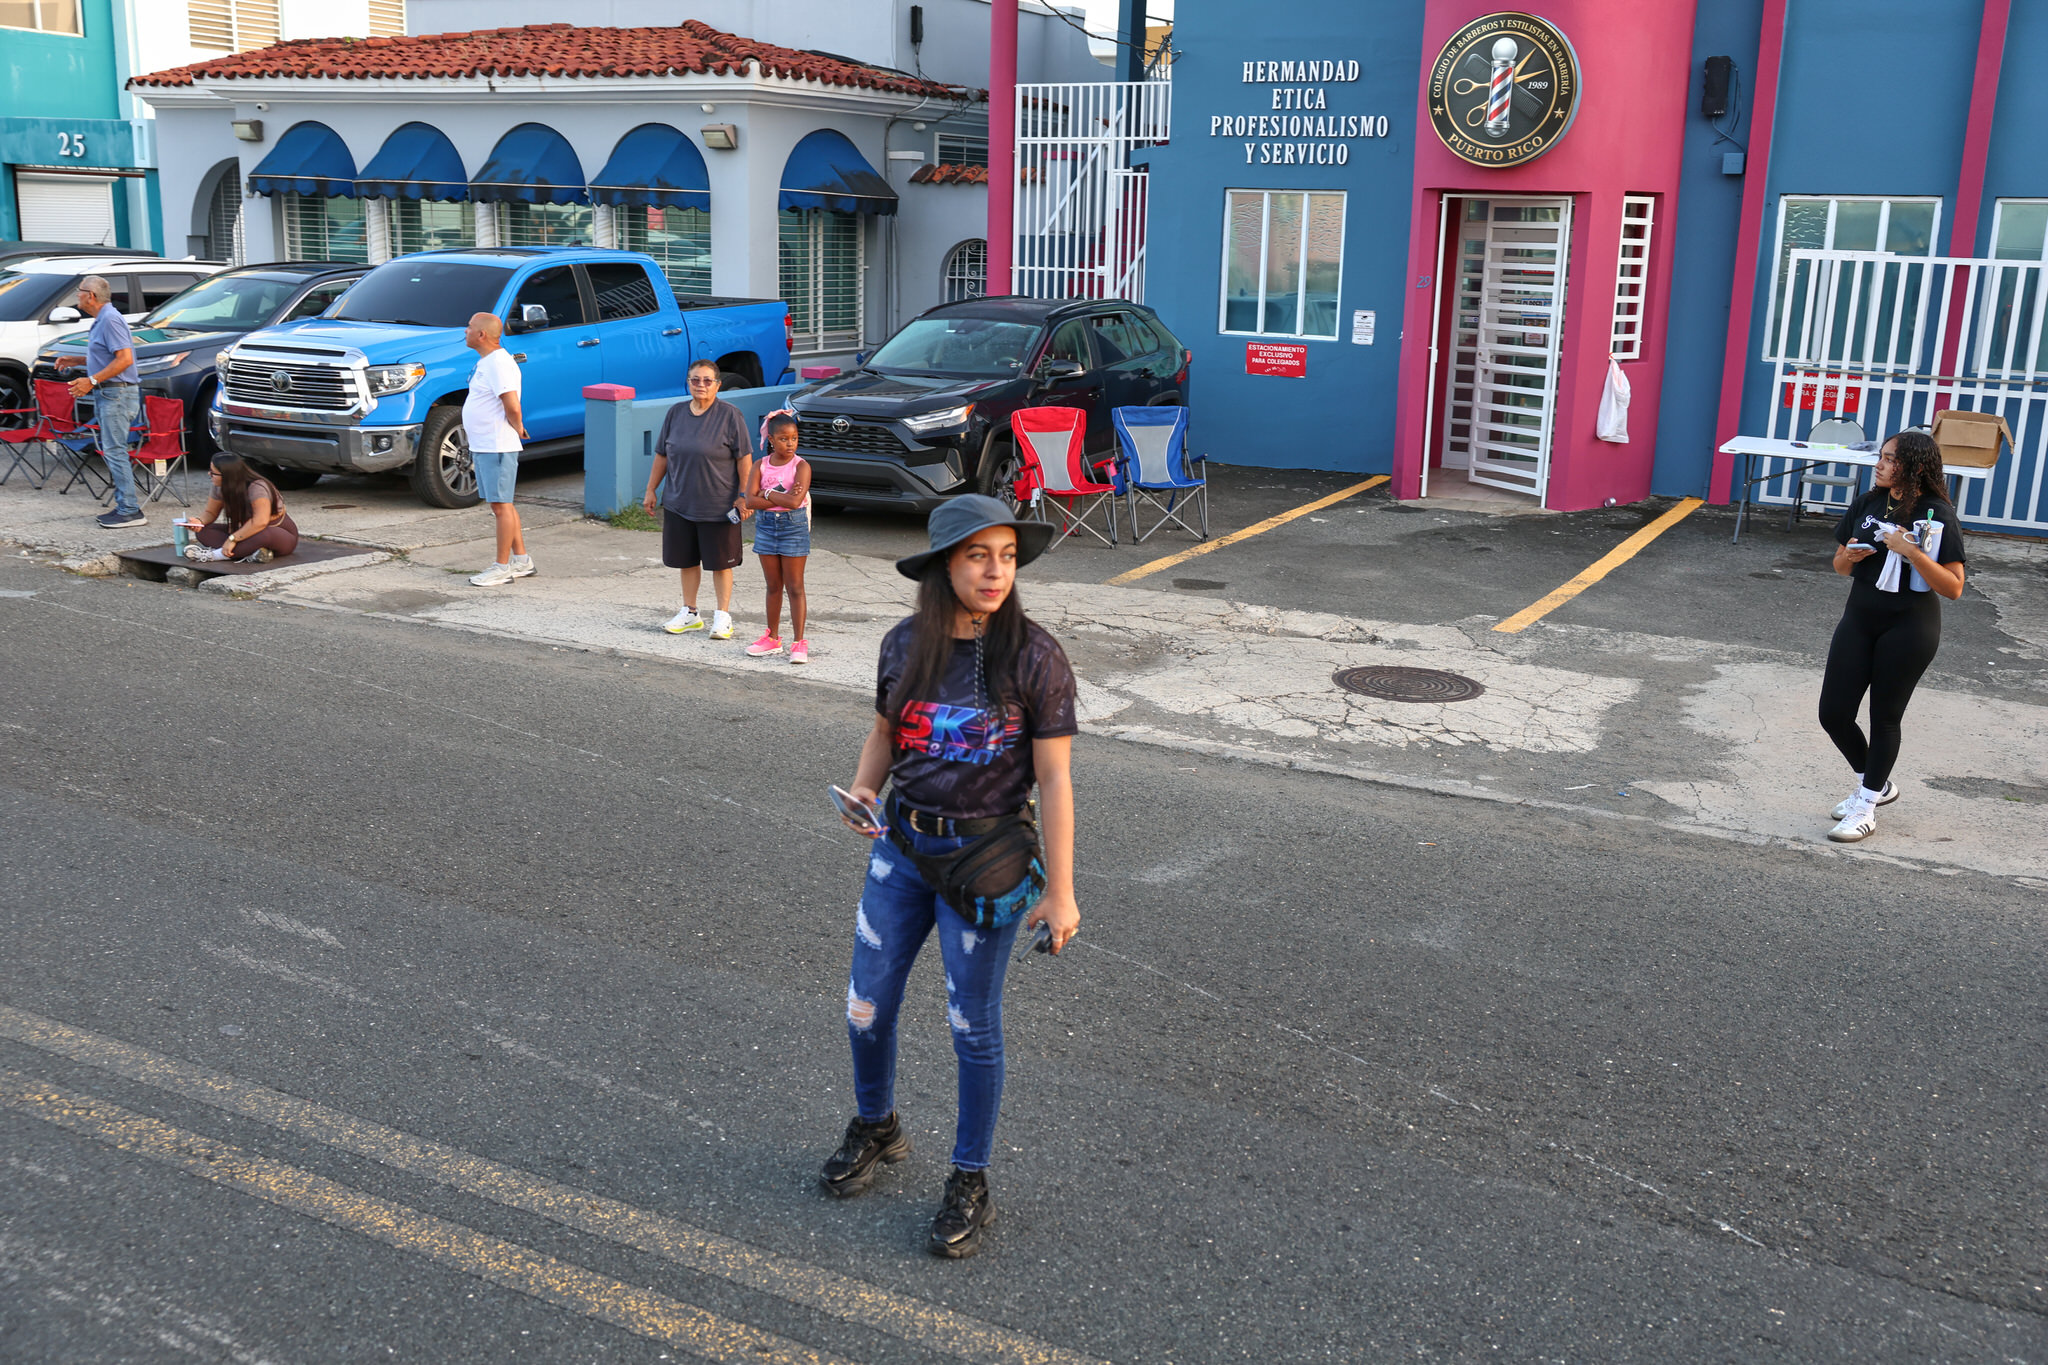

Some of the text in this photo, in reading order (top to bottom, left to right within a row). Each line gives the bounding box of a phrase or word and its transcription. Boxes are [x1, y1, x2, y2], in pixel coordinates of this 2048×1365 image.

[1433, 20, 1571, 98] COLEGIO DE BARBEROS Y ESTILISTAS EN BARBERÍA
[1242, 60, 1360, 83] HERMANDAD
[1527, 81, 1549, 90] 1989
[1271, 88, 1327, 110] ETICA
[1210, 115, 1389, 138] PROFESIONALISMO
[57, 131, 86, 158] 25
[1244, 142, 1349, 165] Y SERVICIO
[1447, 132, 1543, 161] PUERTO RICO
[1416, 275, 1432, 288] 29
[1248, 344, 1305, 353] ESTACIONAMIENTO
[1267, 358, 1300, 366] COLEGIADOS
[898, 700, 986, 747] 5K
[928, 743, 942, 757] &
[942, 744, 994, 765] RUN
